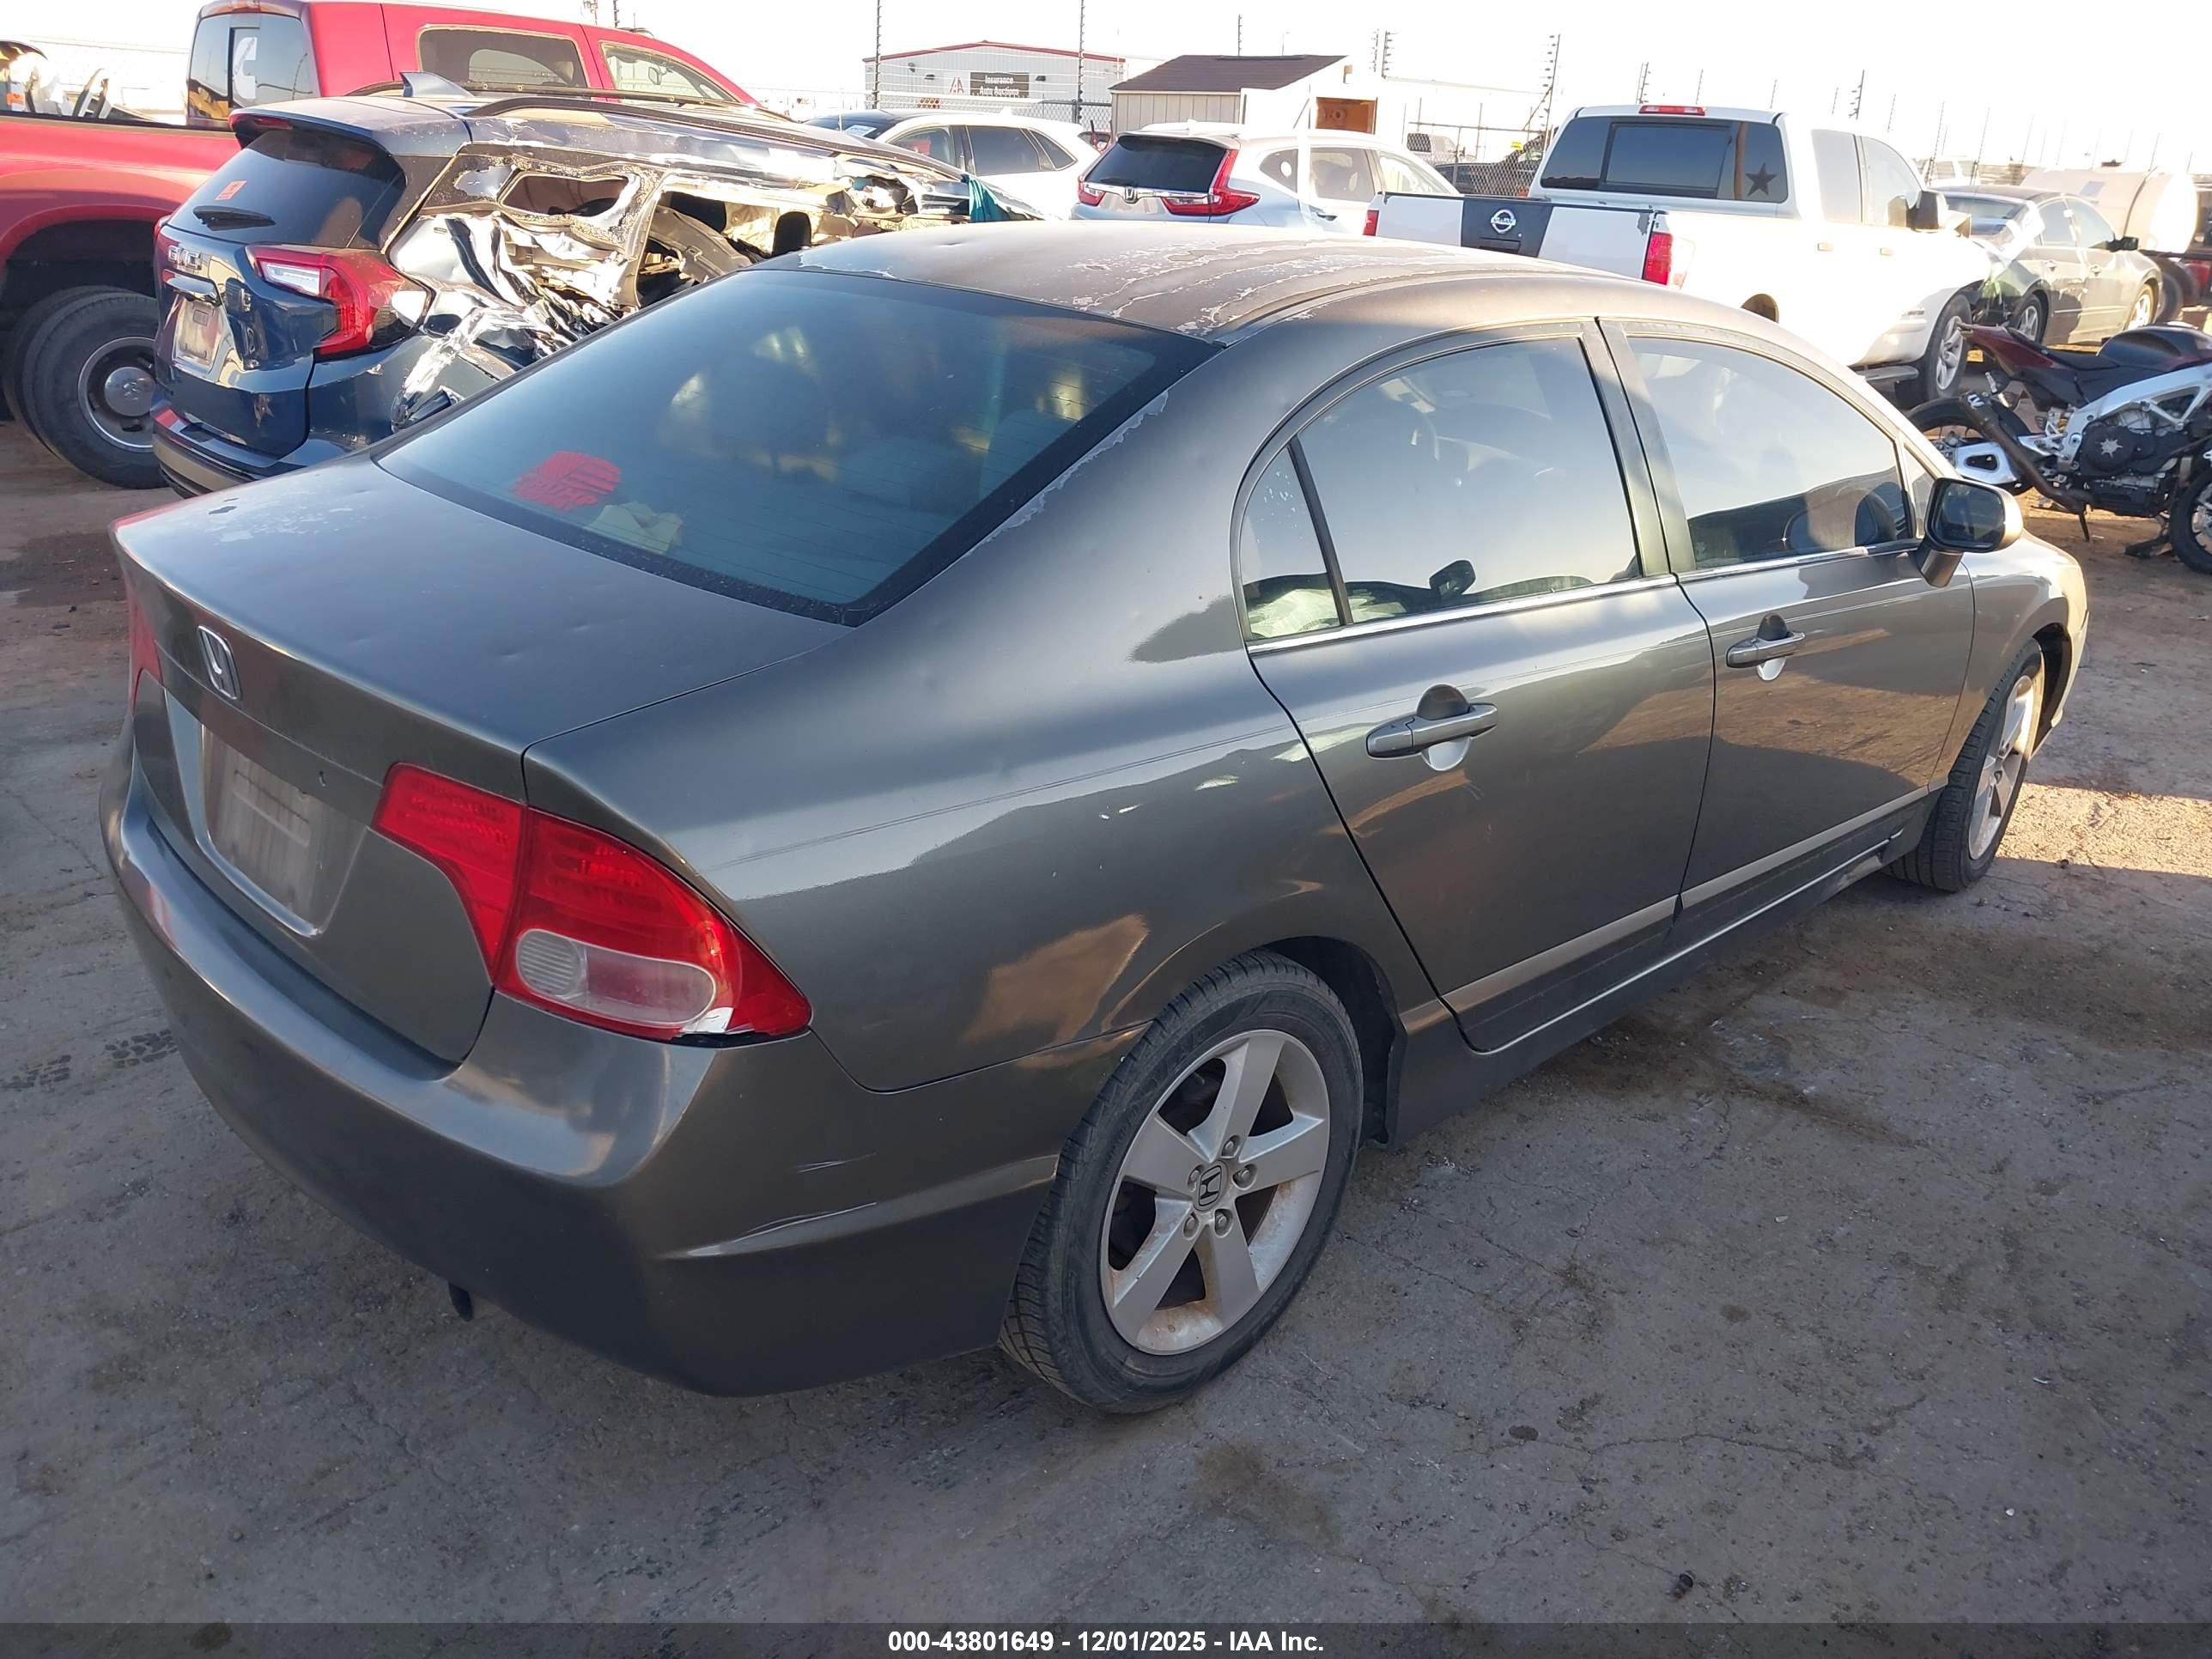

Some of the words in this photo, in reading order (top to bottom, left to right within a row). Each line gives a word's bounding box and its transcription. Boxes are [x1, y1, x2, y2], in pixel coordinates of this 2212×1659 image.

[985, 76, 1014, 84] Insurance
[979, 86, 993, 94] Auto
[994, 86, 1019, 95] Auctions
